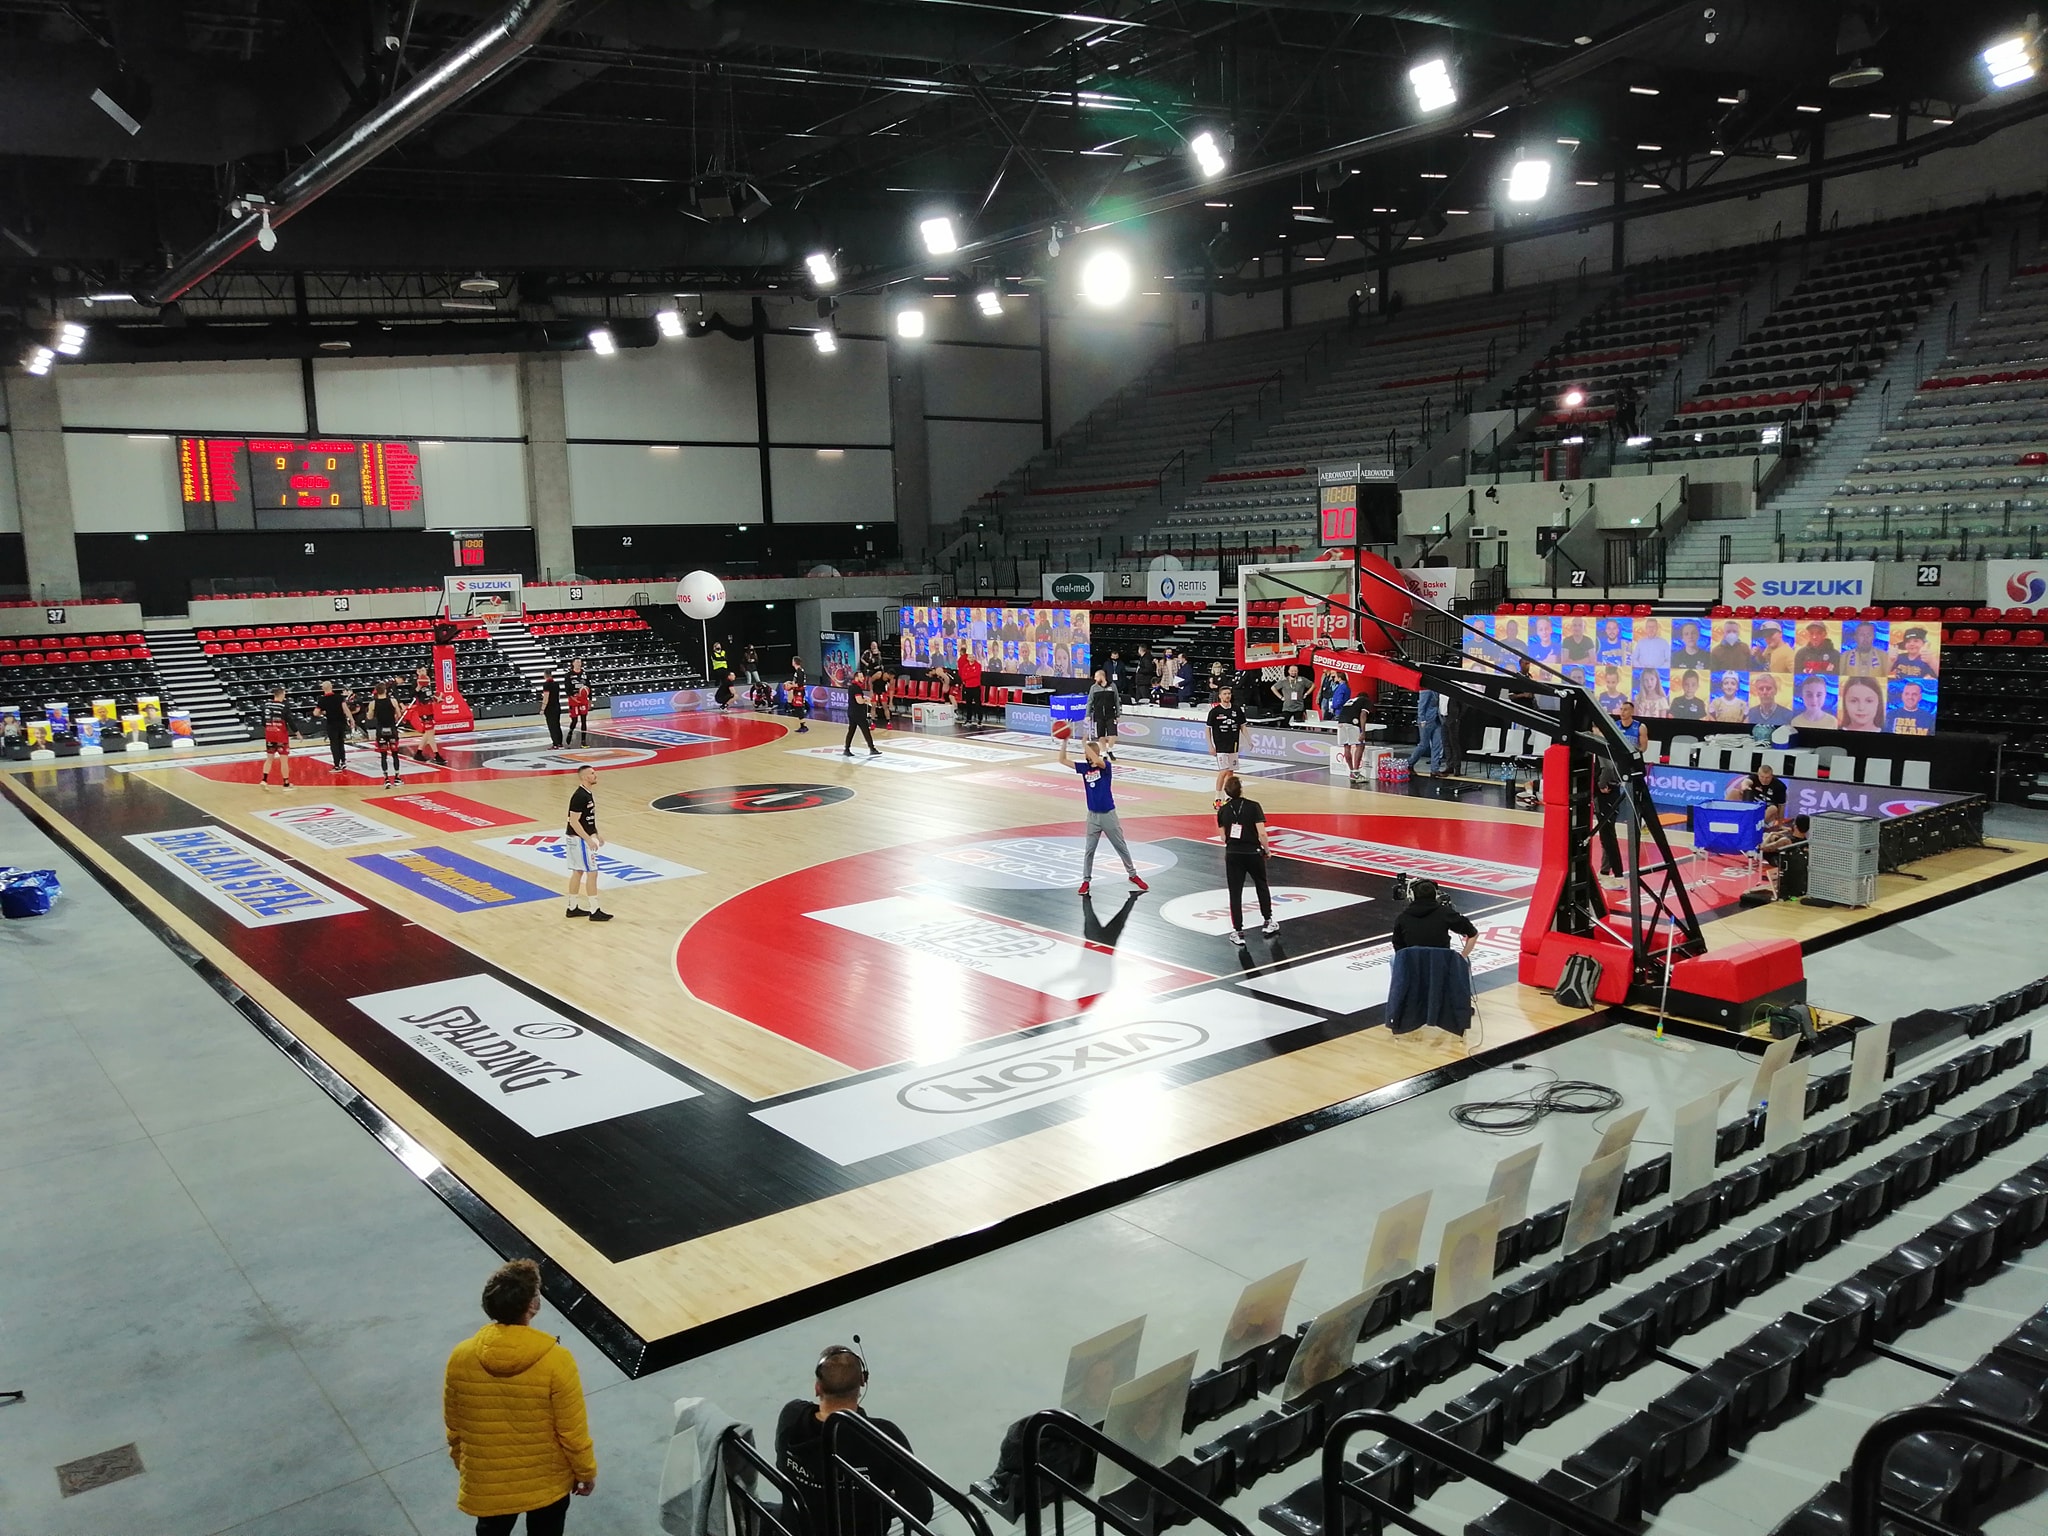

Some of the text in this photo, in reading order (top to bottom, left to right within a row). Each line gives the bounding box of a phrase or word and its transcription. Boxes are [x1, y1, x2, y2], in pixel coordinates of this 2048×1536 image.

[276, 457, 285, 470] 9
[327, 457, 336, 470] 0
[1320, 470, 1358, 480] AEROWATCH
[1360, 468, 1394, 477] AEROWATCH
[1325, 485, 1356, 503] 10:00
[622, 536, 633, 546] 22
[304, 543, 315, 553] 21
[1121, 575, 1130, 586] 25
[1571, 571, 1585, 584] 27
[1918, 567, 1938, 582] 28
[469, 581, 512, 590] SUZUKI
[1055, 582, 1091, 593] enel-med
[1423, 581, 1447, 589] Basket
[1762, 579, 1863, 596] SUZUKI
[570, 588, 582, 598] 39
[1423, 589, 1438, 598] Liga
[335, 598, 348, 609] 38
[48, 609, 63, 621] 37
[1291, 613, 1348, 633] Energa
[1313, 654, 1366, 672] SPORT SYSTEM
[620, 697, 665, 708] molten
[1012, 710, 1048, 723] molten
[1161, 726, 1206, 739] molten
[1251, 734, 1287, 750] SMJ
[1799, 788, 1868, 812] SMJ
[536, 845, 665, 882] SUKI
[144, 830, 335, 919] BM SLAM STAL
[397, 1005, 584, 1095] SPALDING
